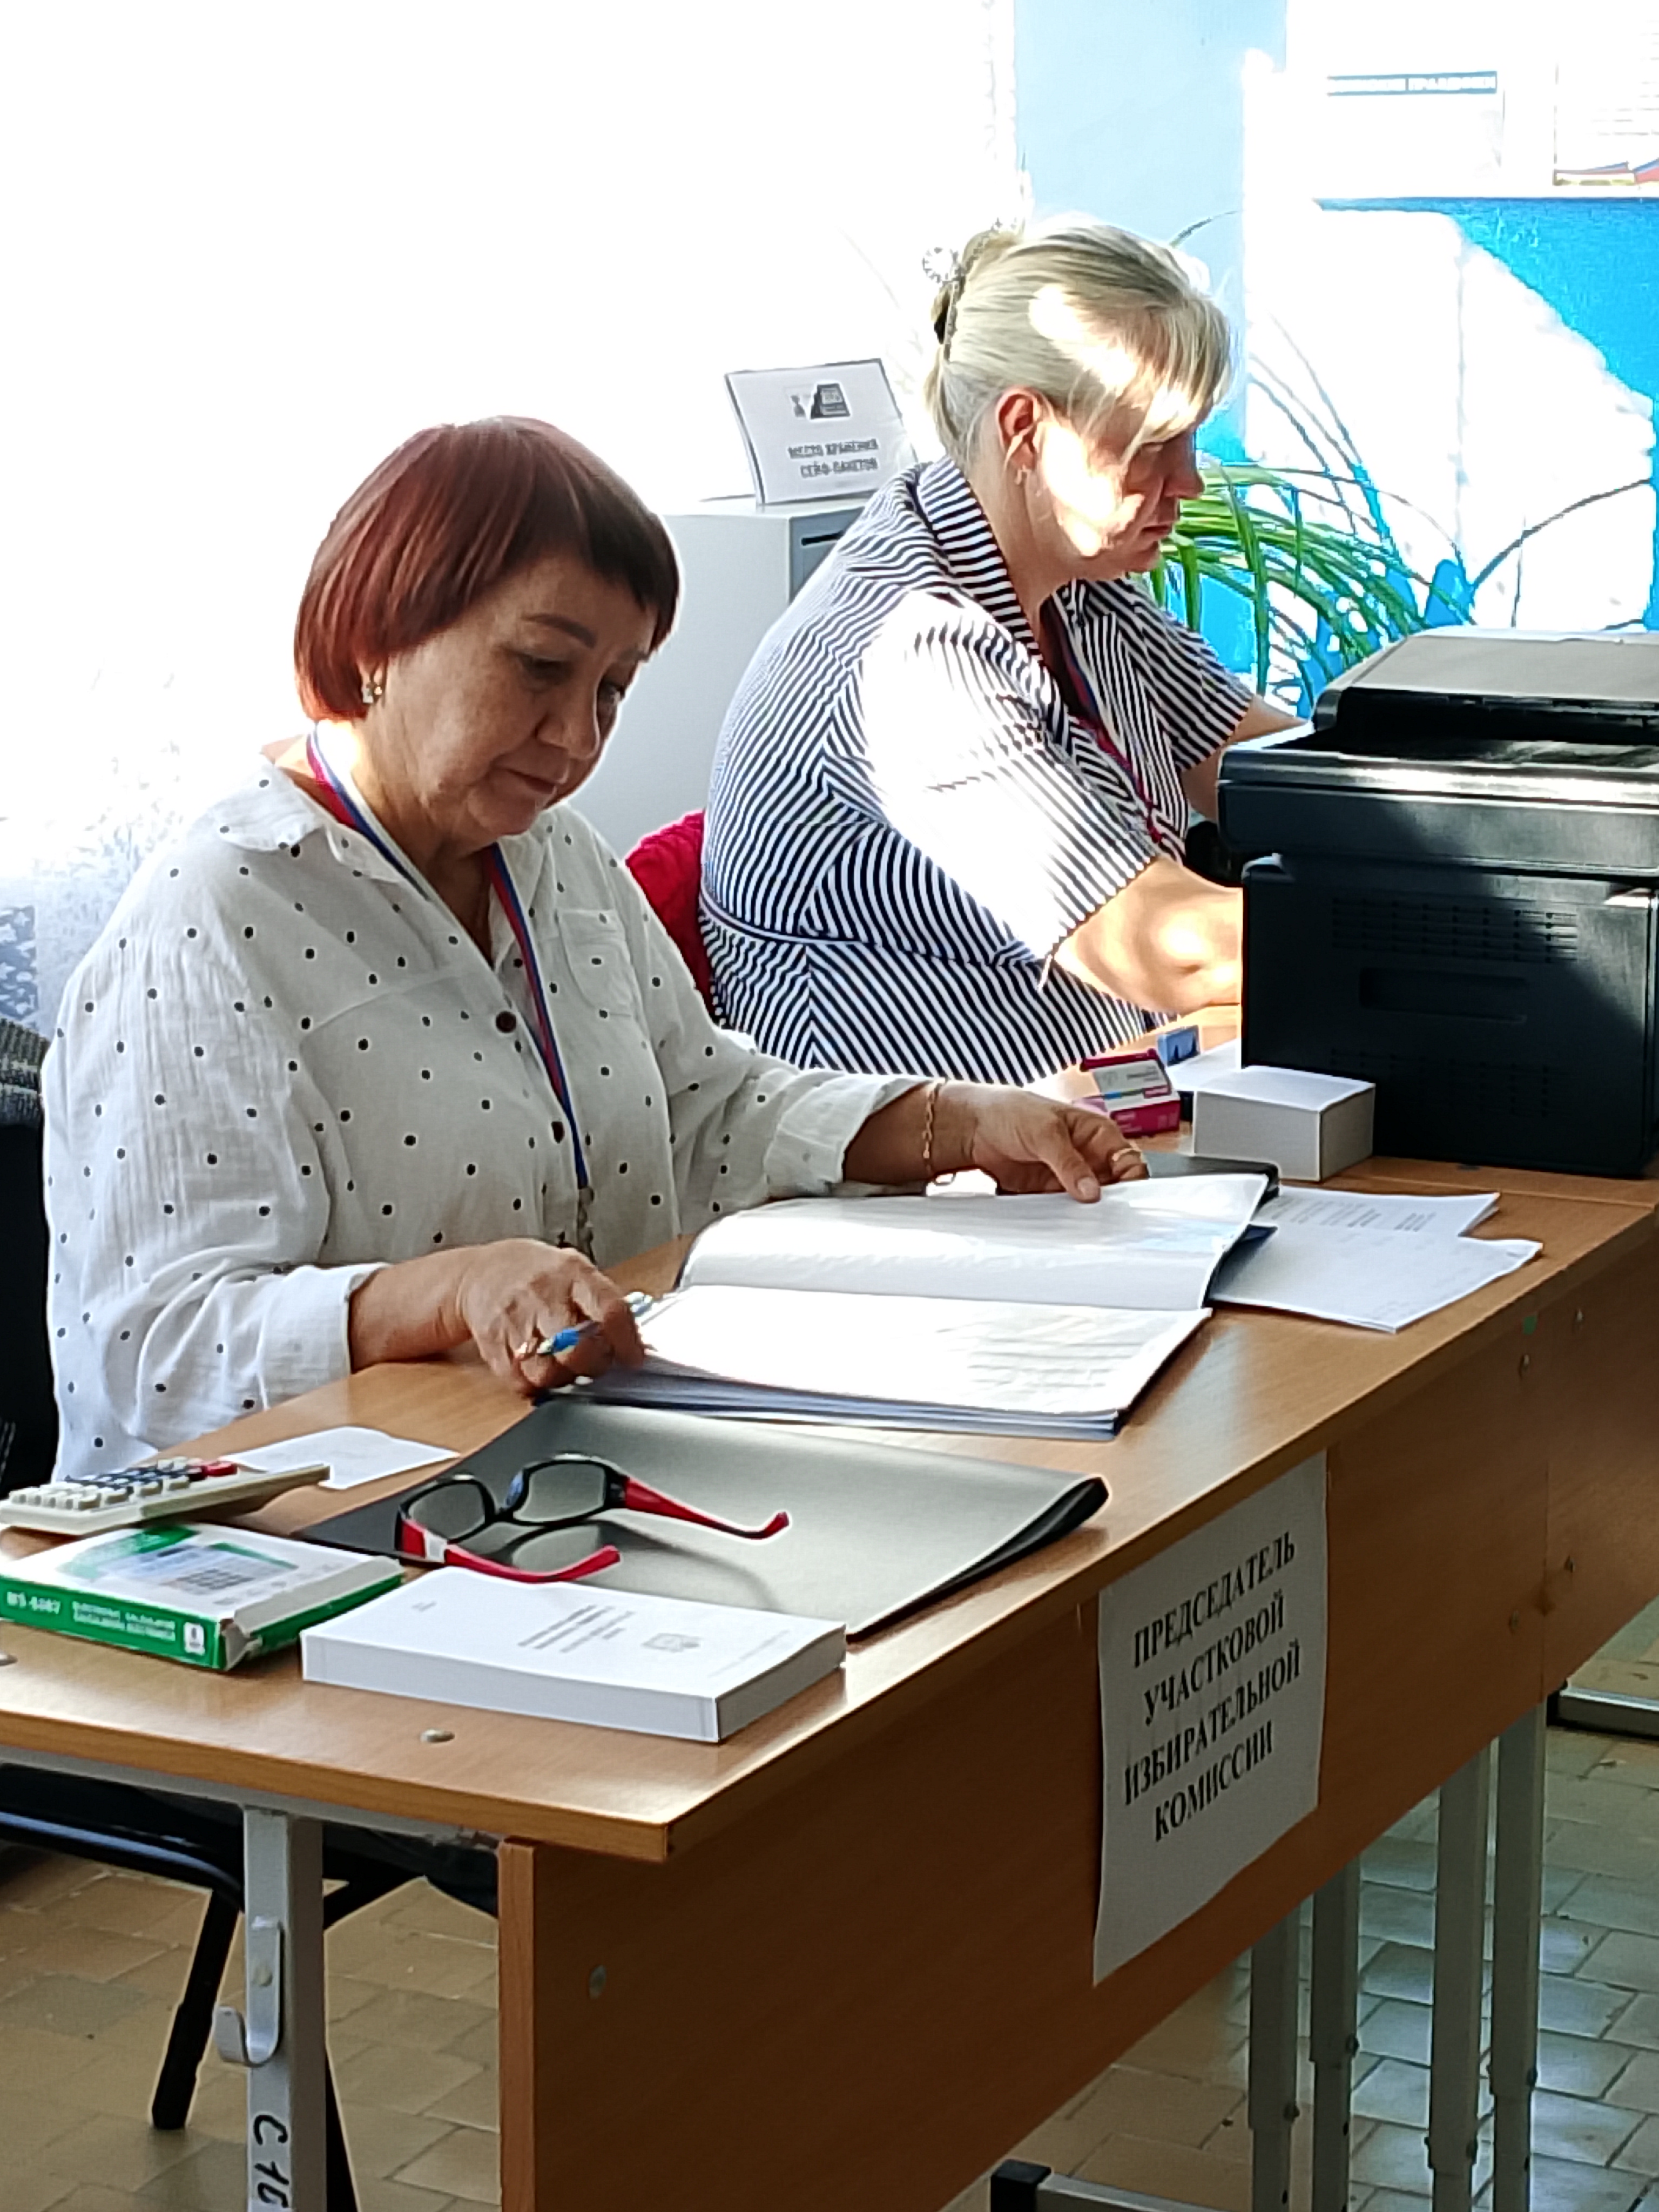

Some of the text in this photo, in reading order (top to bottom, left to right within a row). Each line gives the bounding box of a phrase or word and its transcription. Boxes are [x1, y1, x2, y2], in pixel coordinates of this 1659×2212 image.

[1134, 1530, 1295, 1668] ПРЕДСЕДАТЕЛЬ
[1143, 1588, 1285, 1727] УЧАСТКОВОЙ
[1124, 1637, 1300, 1806] ИЗБИРАТЕЛЬНОЙ
[1154, 1720, 1273, 1842] КОМИССИИ
